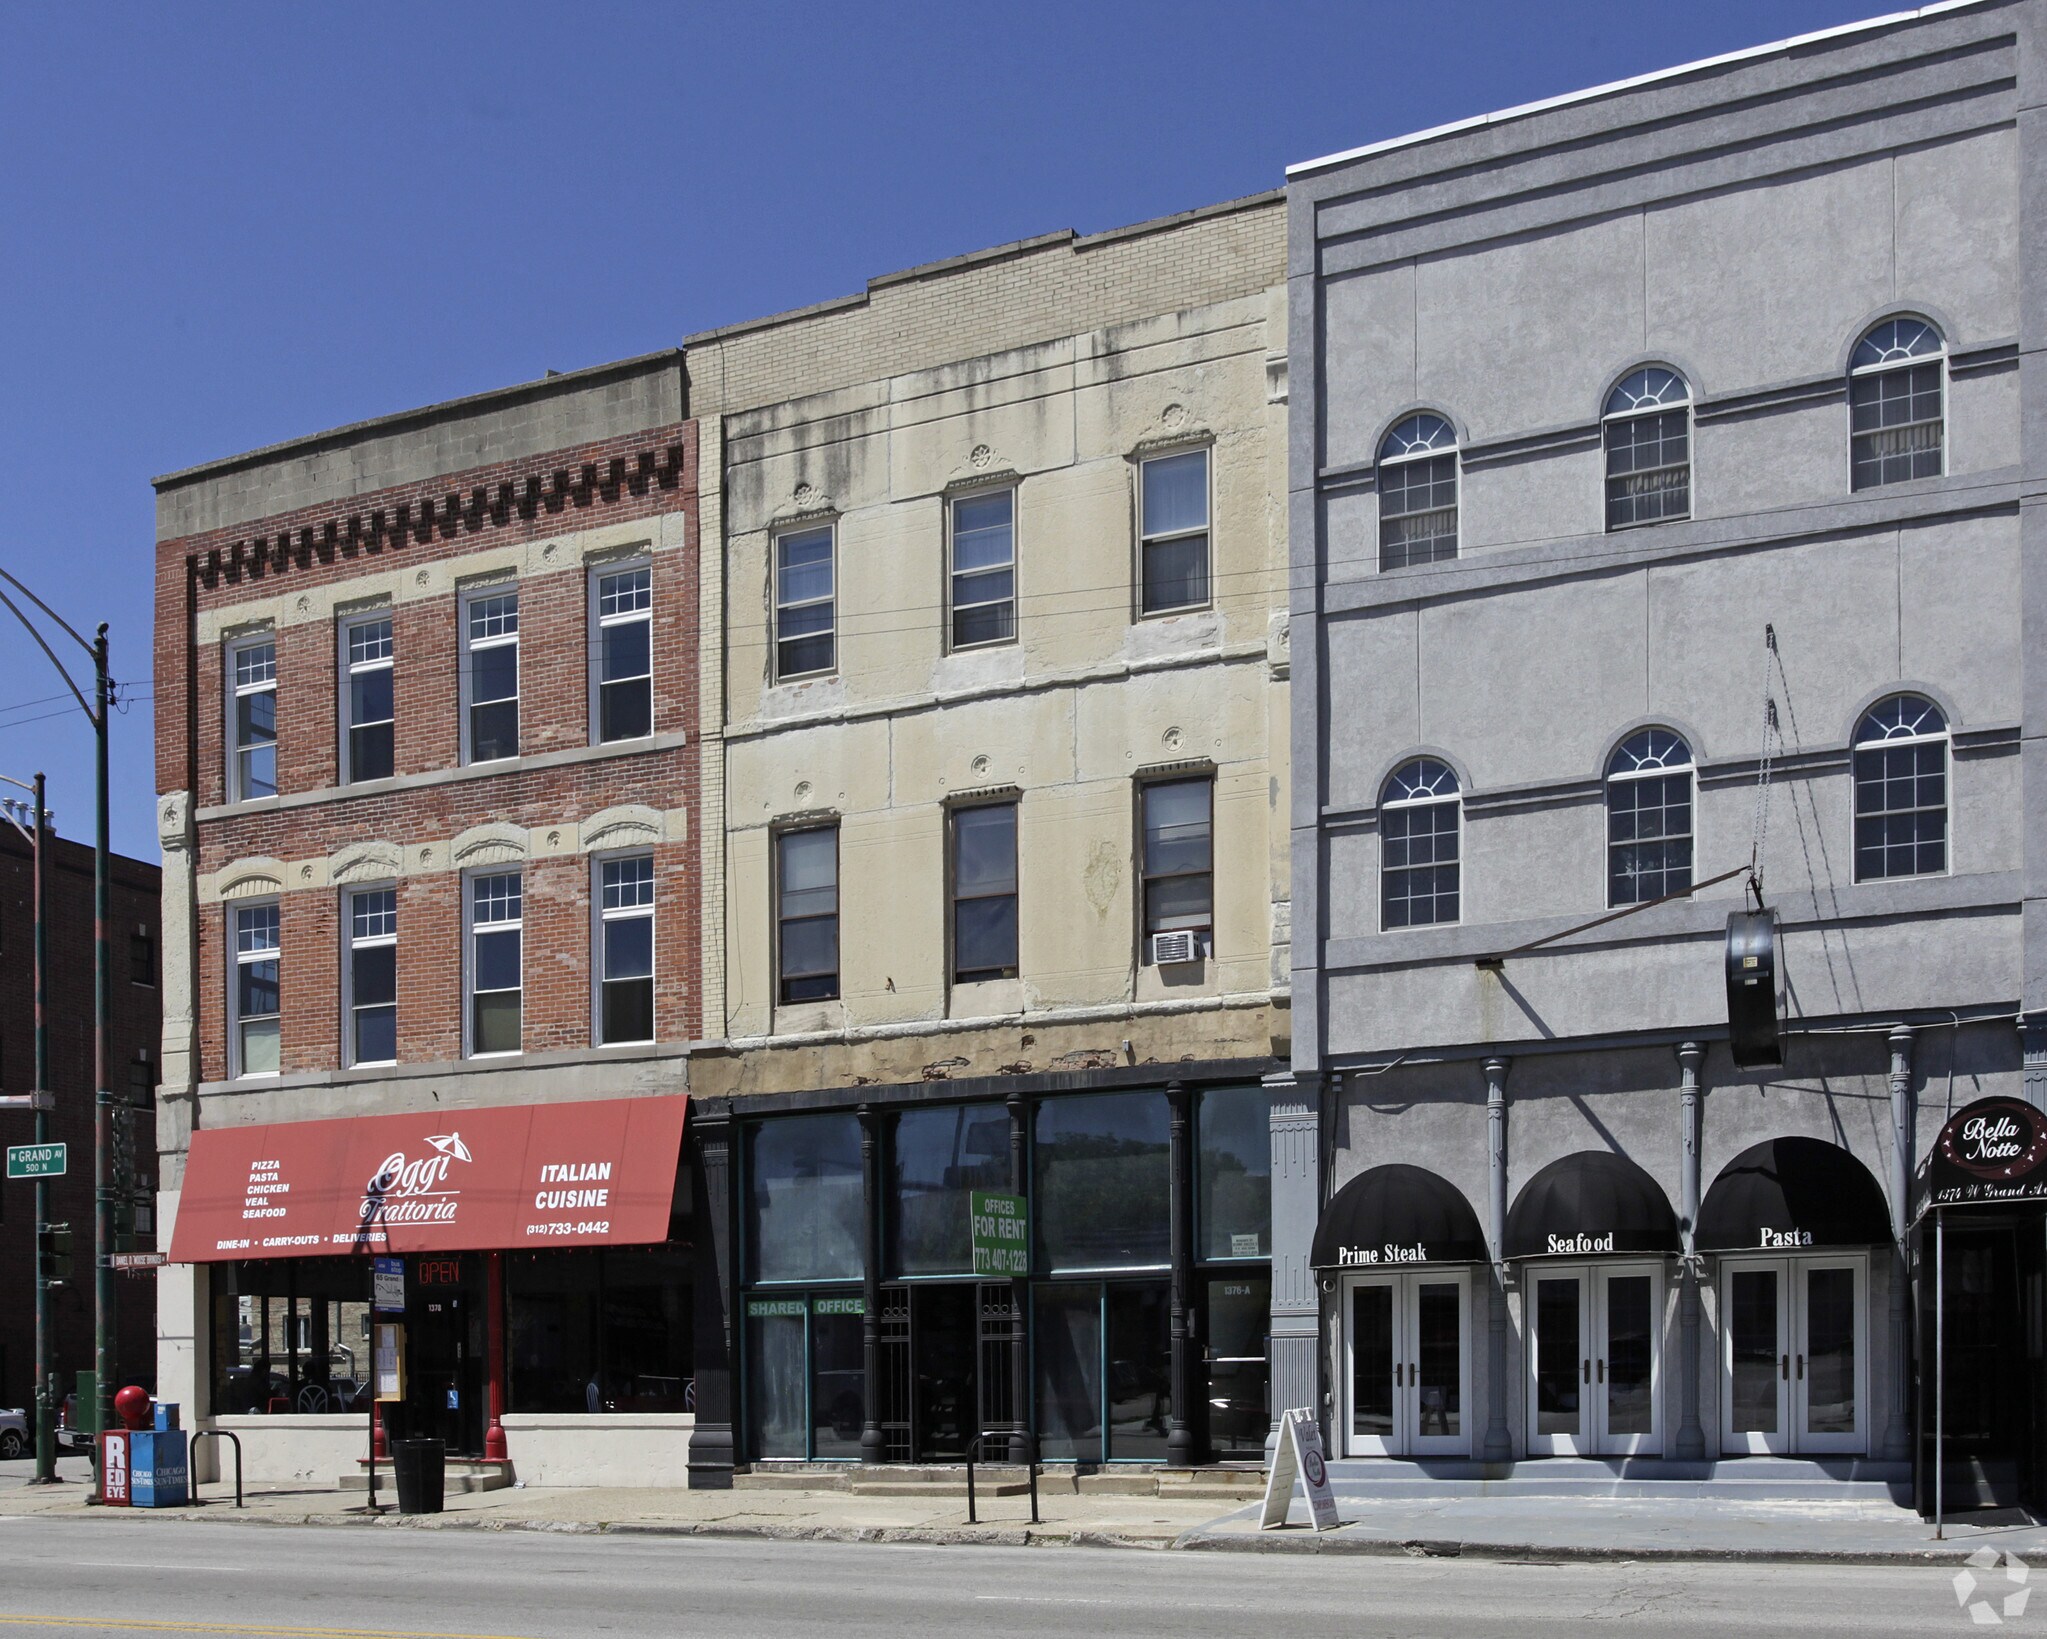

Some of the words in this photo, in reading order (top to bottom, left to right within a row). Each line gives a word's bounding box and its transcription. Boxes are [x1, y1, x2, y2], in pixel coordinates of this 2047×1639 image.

[1963, 1117, 2019, 1140] Bella
[10, 1153, 16, 1161] W
[18, 1149, 52, 1162] GRAND
[54, 1150, 63, 1158] AV
[1966, 1137, 2021, 1159] Notte
[25, 1163, 39, 1172] 500
[42, 1163, 48, 1171] N
[251, 1160, 280, 1171] PIZZA
[367, 1152, 451, 1197] Oggi
[540, 1162, 612, 1183] ITALIAN
[249, 1172, 279, 1183] PASTA
[247, 1183, 290, 1195] CHICKEN
[1937, 1187, 1961, 1202] 1374
[1966, 1184, 1980, 1198] W
[1984, 1183, 2026, 1198] Grand
[245, 1197, 269, 1207] VEAL
[535, 1188, 609, 1210] CUISINE
[984, 1198, 1015, 1215] OFFICES
[242, 1207, 287, 1219] SEAFOOD
[359, 1196, 458, 1223] Trattoria
[526, 1224, 548, 1236] (312)
[548, 1221, 610, 1236] 733-0442
[973, 1215, 996, 1238] FOR
[998, 1217, 1026, 1240] RENT
[1760, 1226, 1813, 1247] Pasta
[216, 1239, 250, 1250] DINE-IN
[262, 1234, 320, 1247] CARRY-OUTS
[332, 1232, 387, 1244] DELIVERIES
[1547, 1231, 1614, 1253] Seafood
[975, 1246, 991, 1270] 773
[992, 1247, 1028, 1272] 407-1228
[1338, 1245, 1379, 1265] Prime
[1384, 1242, 1427, 1262] Steak
[420, 1261, 459, 1284] OPEN
[1224, 1285, 1251, 1296] 1376-A
[750, 1302, 805, 1316] SHARED
[817, 1300, 862, 1313] OFFICE
[106, 1435, 126, 1468] R
[106, 1468, 126, 1486] ED
[132, 1469, 152, 1477] CHICAGO
[156, 1466, 186, 1476] CHICAGO
[106, 1487, 126, 1498] EYE
